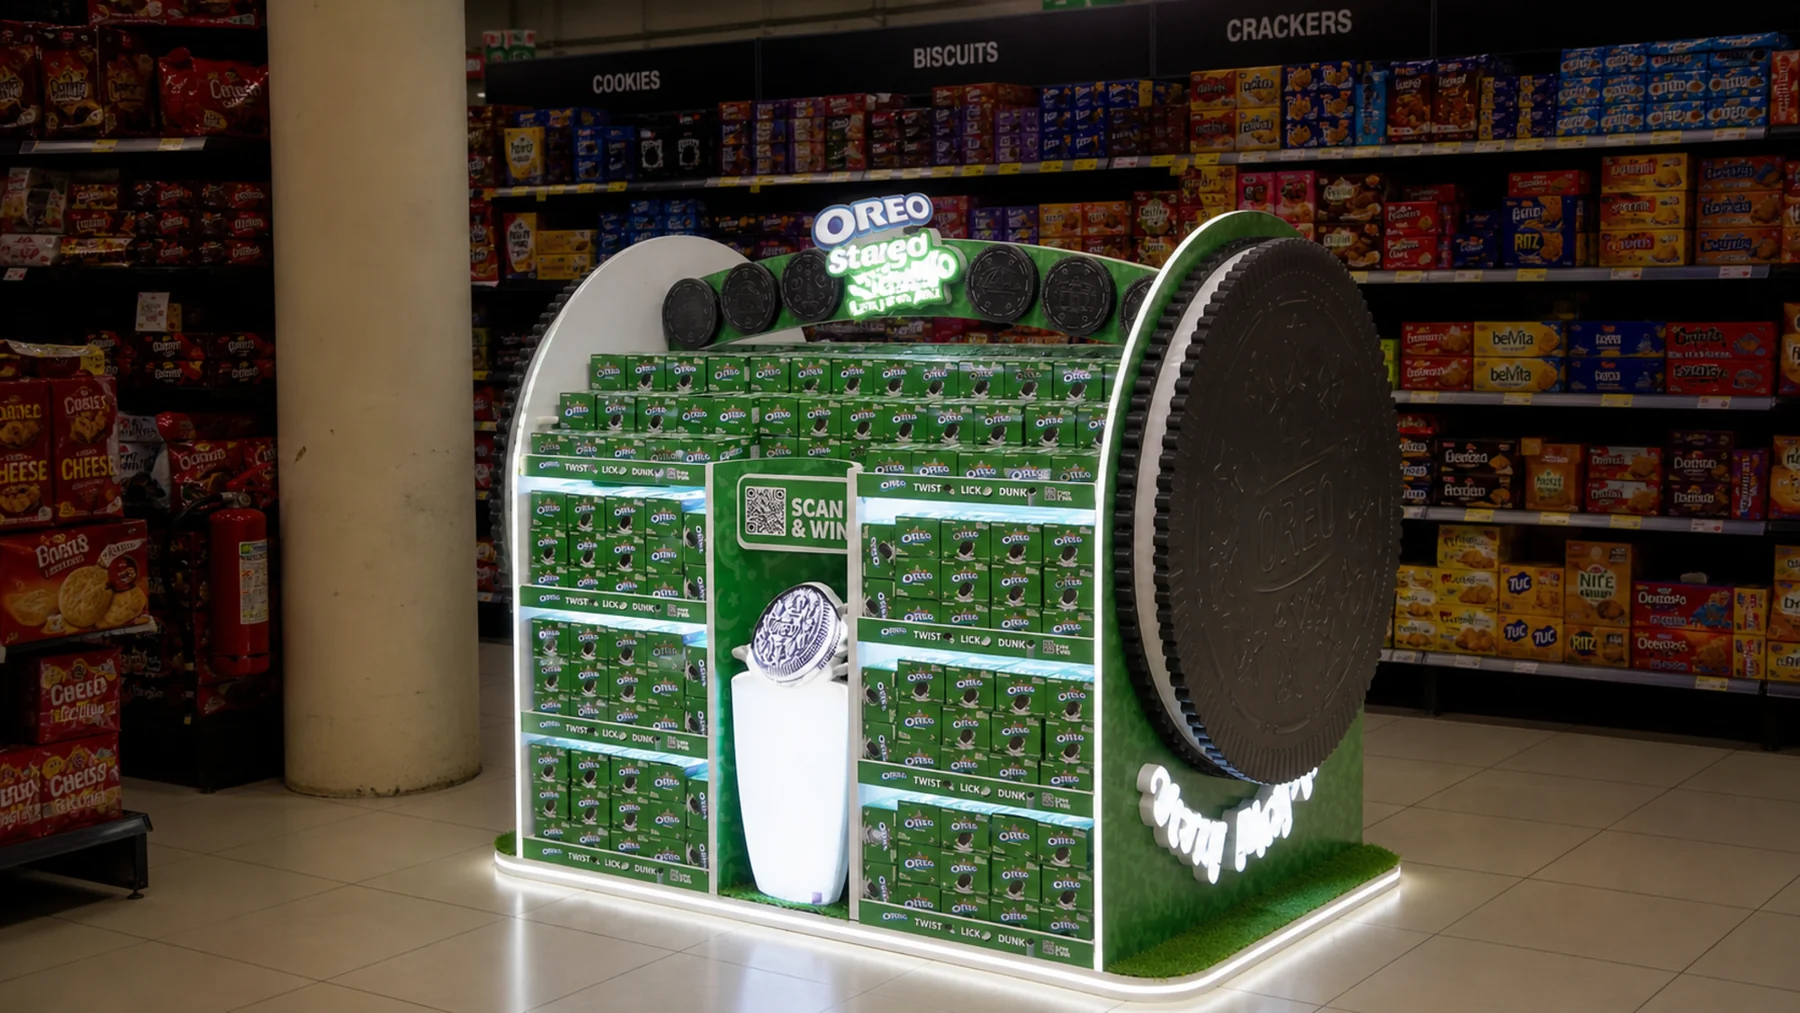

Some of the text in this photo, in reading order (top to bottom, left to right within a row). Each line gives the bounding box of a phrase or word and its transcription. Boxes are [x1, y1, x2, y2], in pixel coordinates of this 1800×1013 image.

[1227, 9, 1352, 42] CRACKERS
[913, 41, 998, 69] BISCUITS
[592, 70, 660, 94] COOKIES
[815, 195, 929, 245] OREO
[1493, 331, 1534, 346] belVita
[1490, 367, 1531, 381] belVita
[61, 455, 115, 481] CHEESE
[565, 464, 588, 472] TWIST
[914, 483, 941, 492] TWIST
[961, 486, 981, 495] LICK
[1000, 487, 1027, 497] DUNK
[791, 498, 843, 518] SCAN
[792, 520, 847, 540] & WIN
[1508, 576, 1531, 591] TUC
[566, 597, 588, 606] TWIST
[1505, 623, 1528, 638] TUC
[1534, 630, 1556, 645] TUC
[914, 631, 941, 641] TWIST
[961, 636, 980, 646] LICK
[998, 638, 1025, 649] DUNK
[566, 724, 588, 734] TWIST
[914, 776, 941, 787] TWIST
[960, 784, 980, 794] LICK
[998, 789, 1025, 801] DUNK
[568, 852, 591, 863] TWIST
[915, 918, 943, 930] TWIST
[961, 927, 980, 938] LICK
[998, 934, 1026, 947] DUNK
